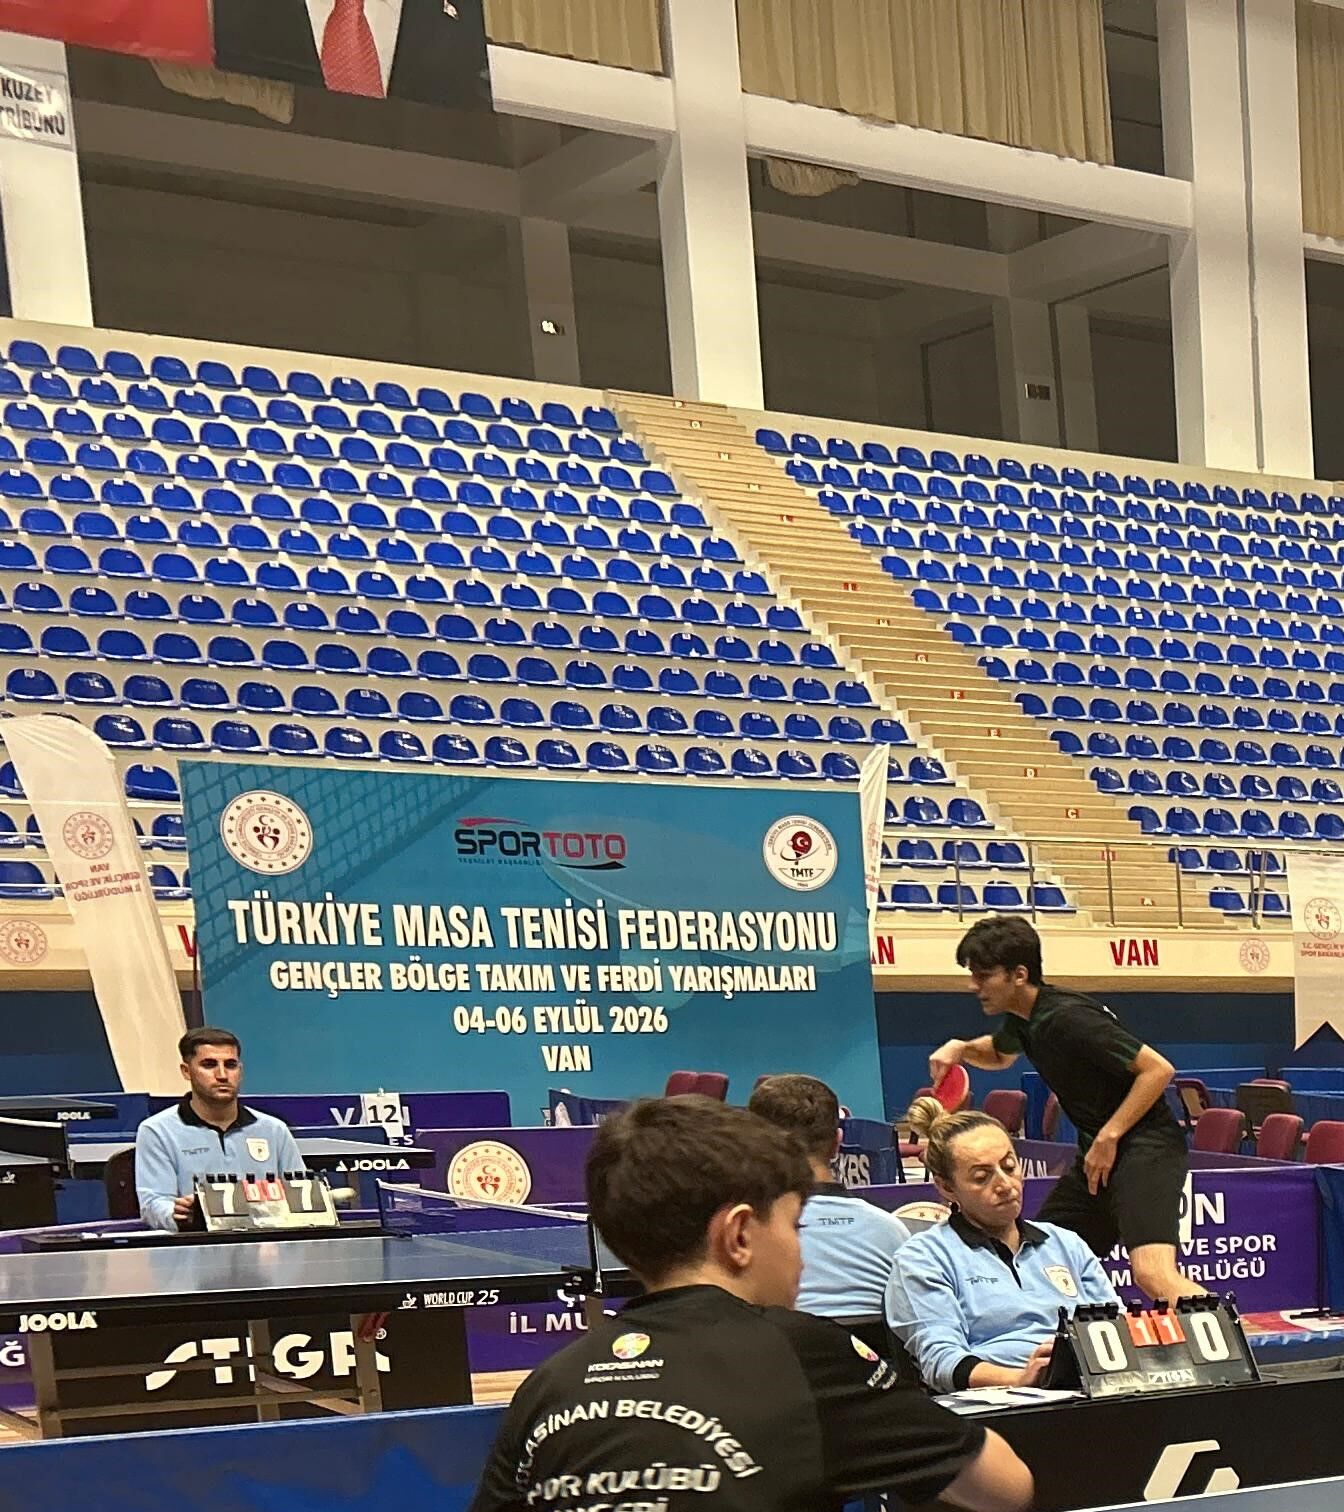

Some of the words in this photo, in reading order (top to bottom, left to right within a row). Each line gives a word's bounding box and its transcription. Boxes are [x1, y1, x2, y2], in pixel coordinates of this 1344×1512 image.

[454, 829, 627, 861] SPORTOTO
[228, 890, 382, 946] TÜRKİYE
[393, 904, 494, 949] MASA
[501, 898, 608, 950] TENİSİ
[618, 910, 838, 951] FEDERASYONU
[1110, 939, 1159, 967] VAN
[270, 960, 383, 998] GENÇLER
[389, 955, 471, 991] BÖLGE
[476, 964, 556, 992] TAKIM
[560, 965, 592, 992] VE
[597, 958, 663, 992] FERDİ
[668, 965, 816, 999] YARIŞMALARI
[453, 1006, 527, 1034] 04-06
[533, 998, 604, 1034] EYLÜL
[610, 1006, 669, 1033] 2026
[541, 1045, 592, 1073] VAN
[57, 1112, 91, 1120] JOOLA
[368, 1104, 399, 1124] 12
[351, 1158, 411, 1171] JOOLA
[212, 1183, 235, 1215] 7
[290, 1180, 313, 1211] 7
[1181, 1239, 1210, 1257] VE
[1216, 1234, 1277, 1255] SPOR
[424, 1293, 456, 1305] WORLD
[456, 1291, 475, 1304] CUP
[477, 1290, 500, 1305] 25
[19, 1311, 98, 1332] JOOLA
[509, 1311, 537, 1333] İL
[1135, 1323, 1152, 1346] 1
[1160, 1320, 1177, 1344] 1
[1087, 1321, 1128, 1371] 0
[1190, 1312, 1230, 1362] 0
[615, 1400, 763, 1479] BELEDİYESİ
[586, 1462, 722, 1495] KULÜBÜ
